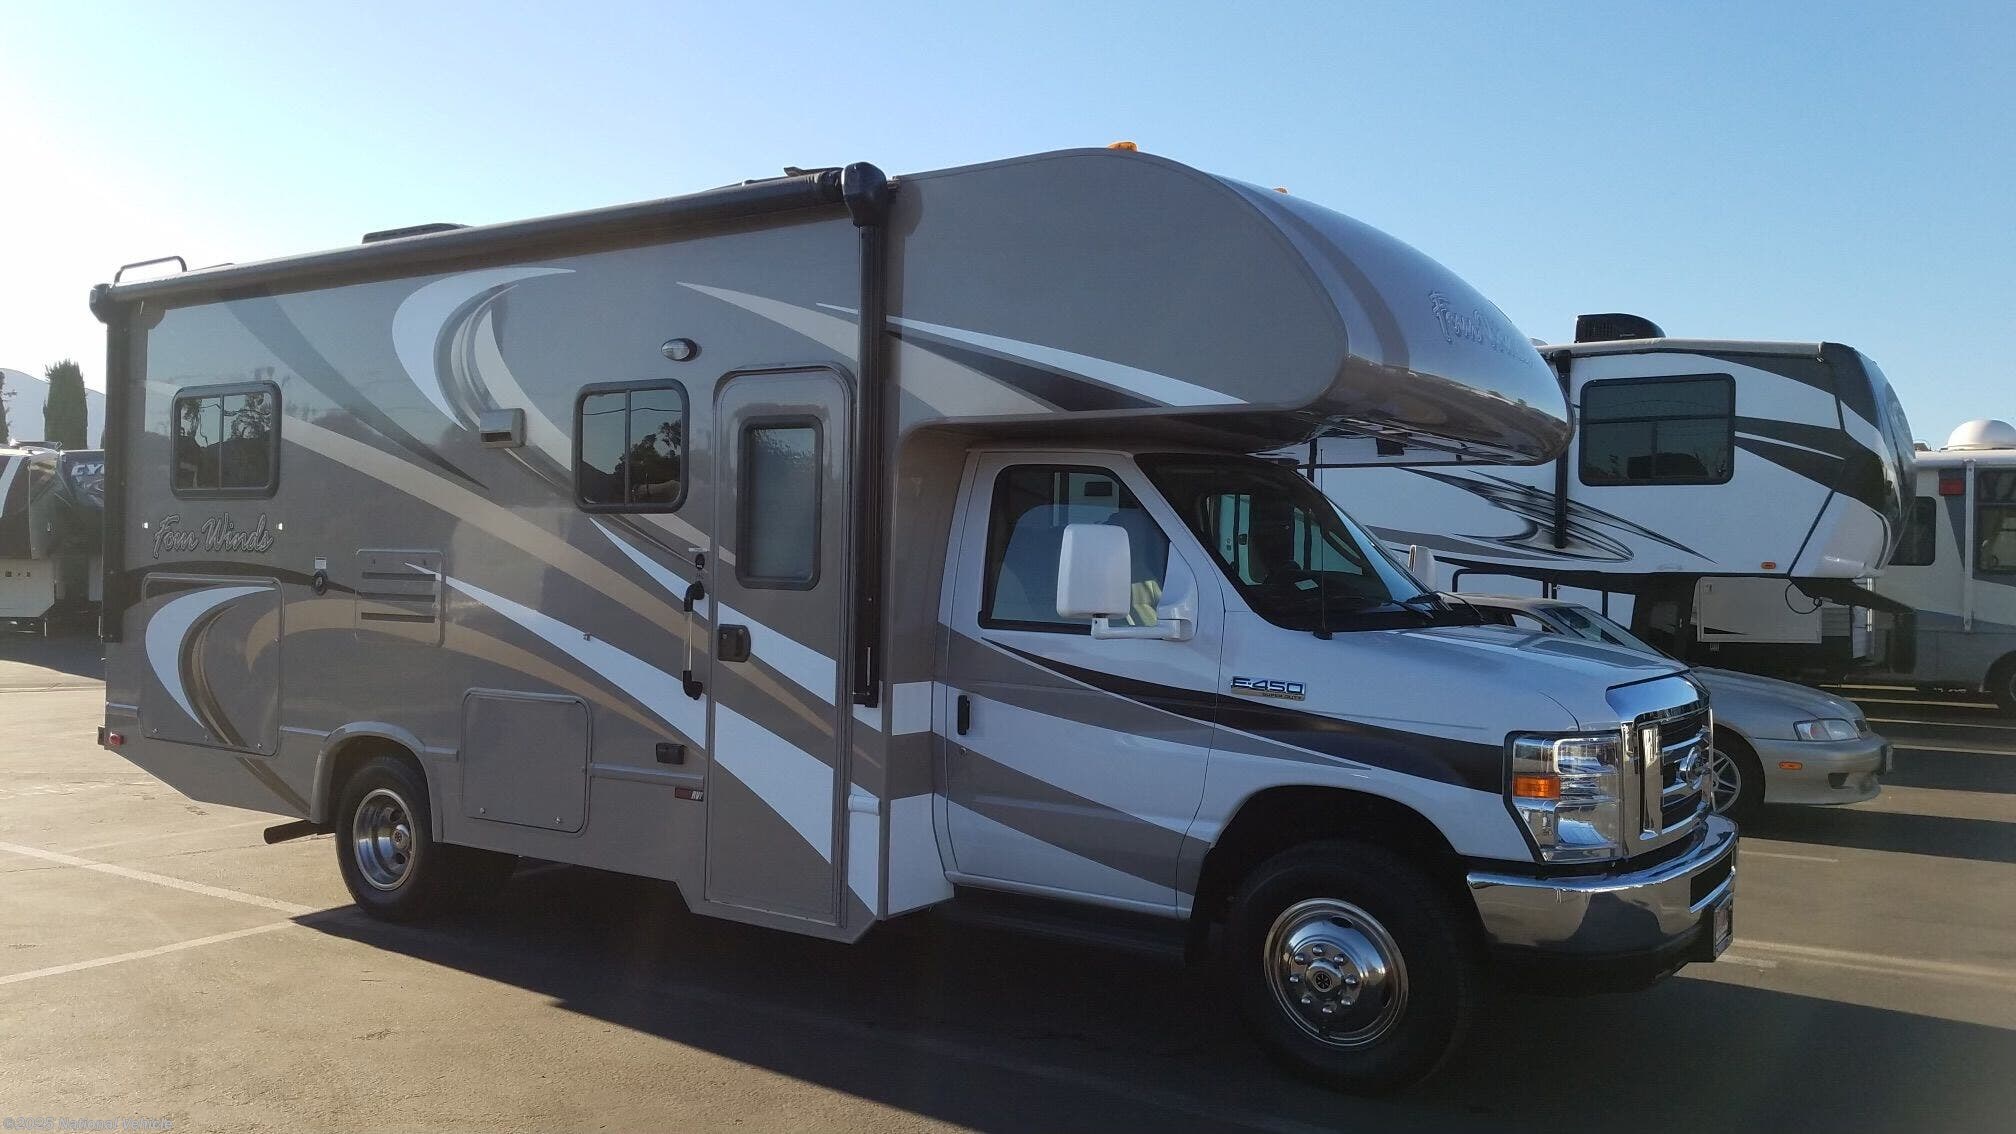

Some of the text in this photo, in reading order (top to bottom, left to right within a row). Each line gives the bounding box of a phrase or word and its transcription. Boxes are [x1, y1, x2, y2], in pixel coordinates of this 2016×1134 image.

[152, 512, 273, 559] Four Winds
[1231, 677, 1304, 694] E-450
